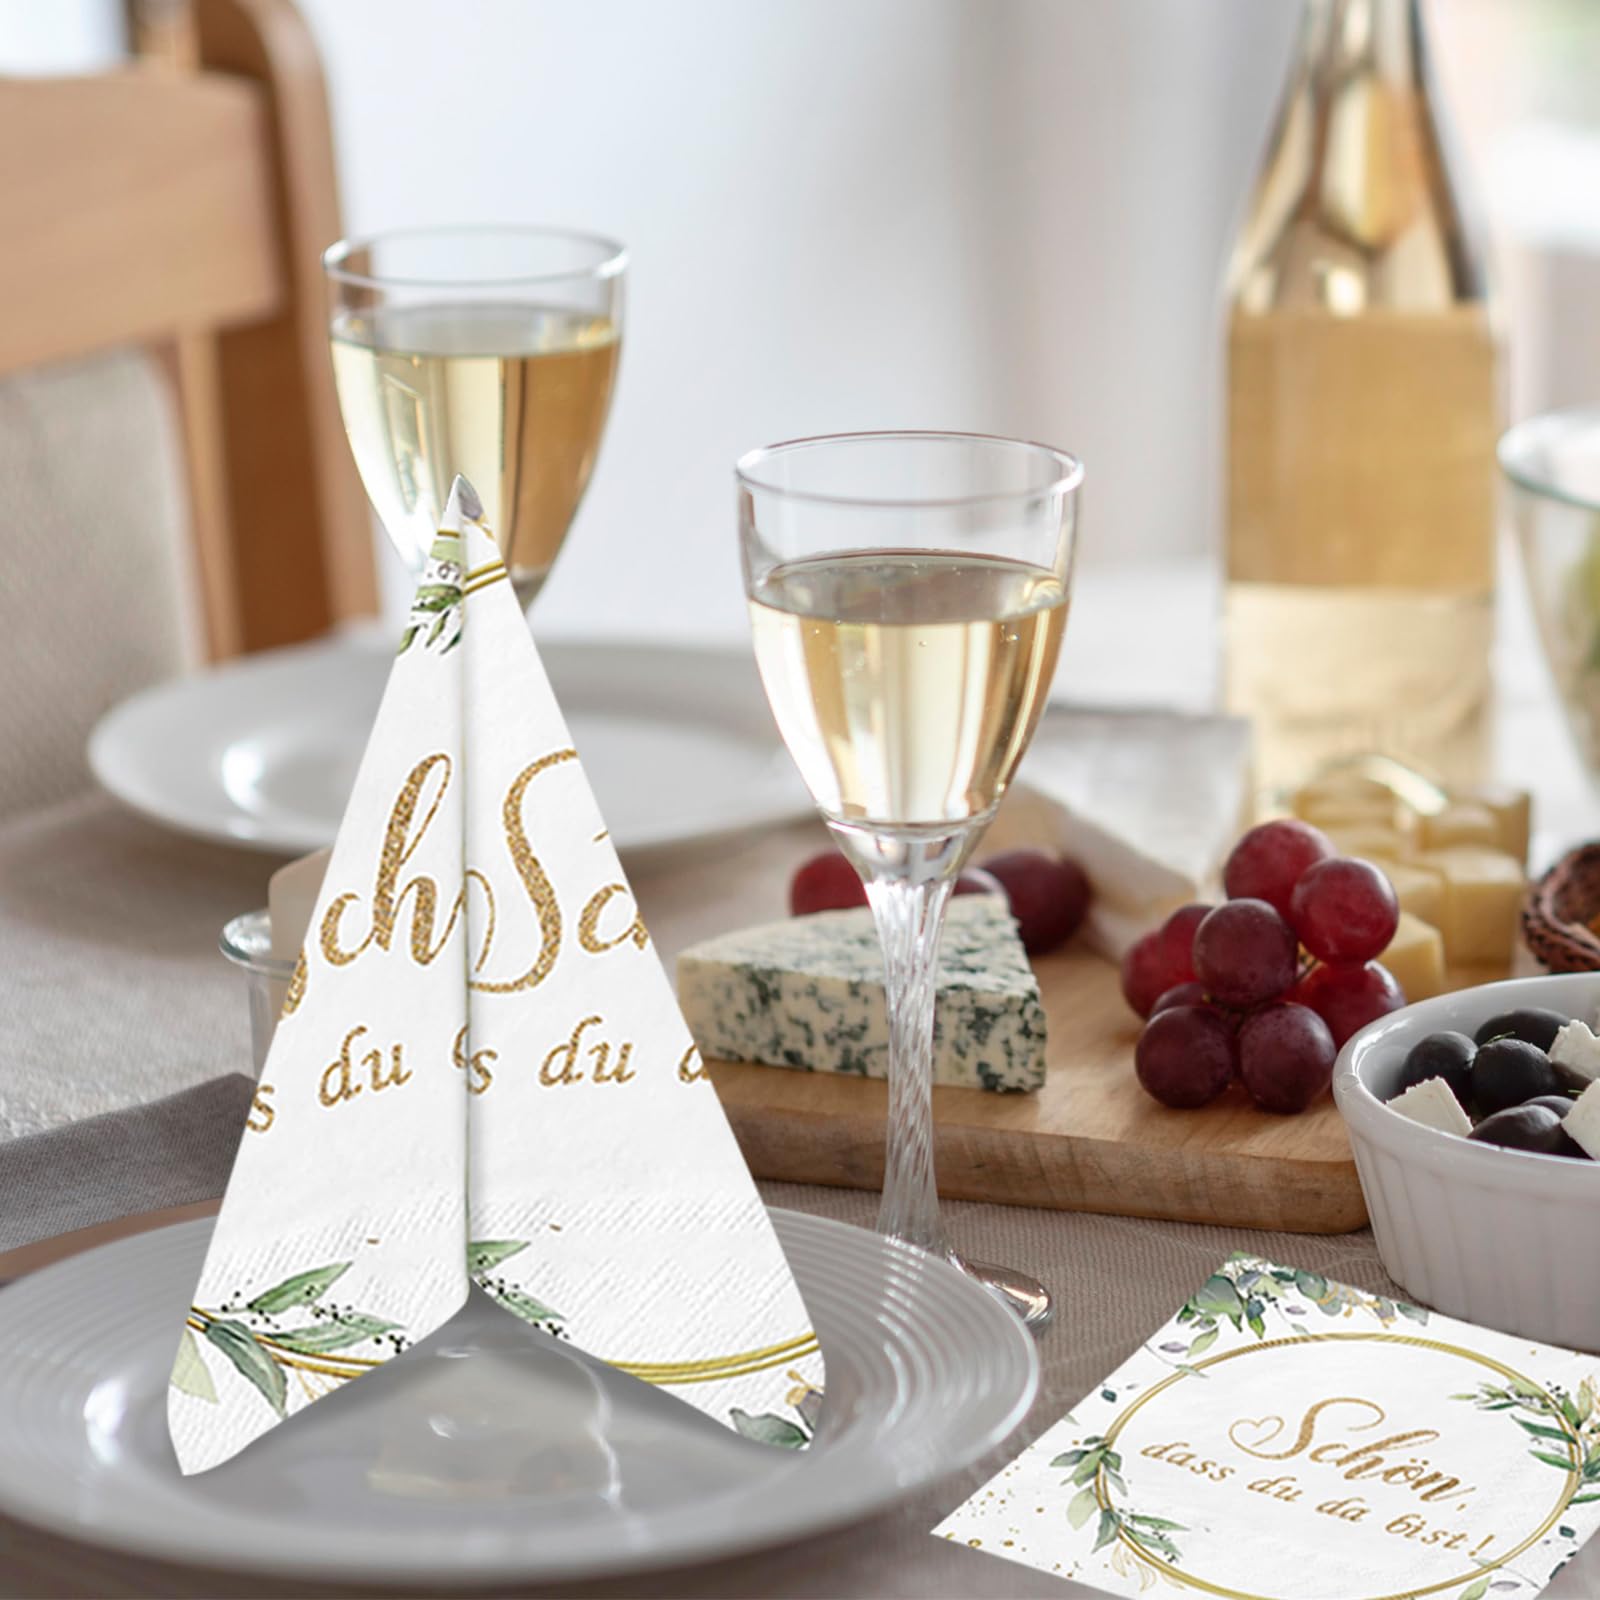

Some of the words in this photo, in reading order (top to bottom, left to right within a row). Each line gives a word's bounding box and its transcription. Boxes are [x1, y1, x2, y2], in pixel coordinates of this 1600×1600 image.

[319, 1025, 413, 1107] du
[539, 1015, 637, 1086] du
[1140, 1442, 1237, 1482] dass
[1246, 1475, 1304, 1503] du
[1315, 1496, 1372, 1523] da
